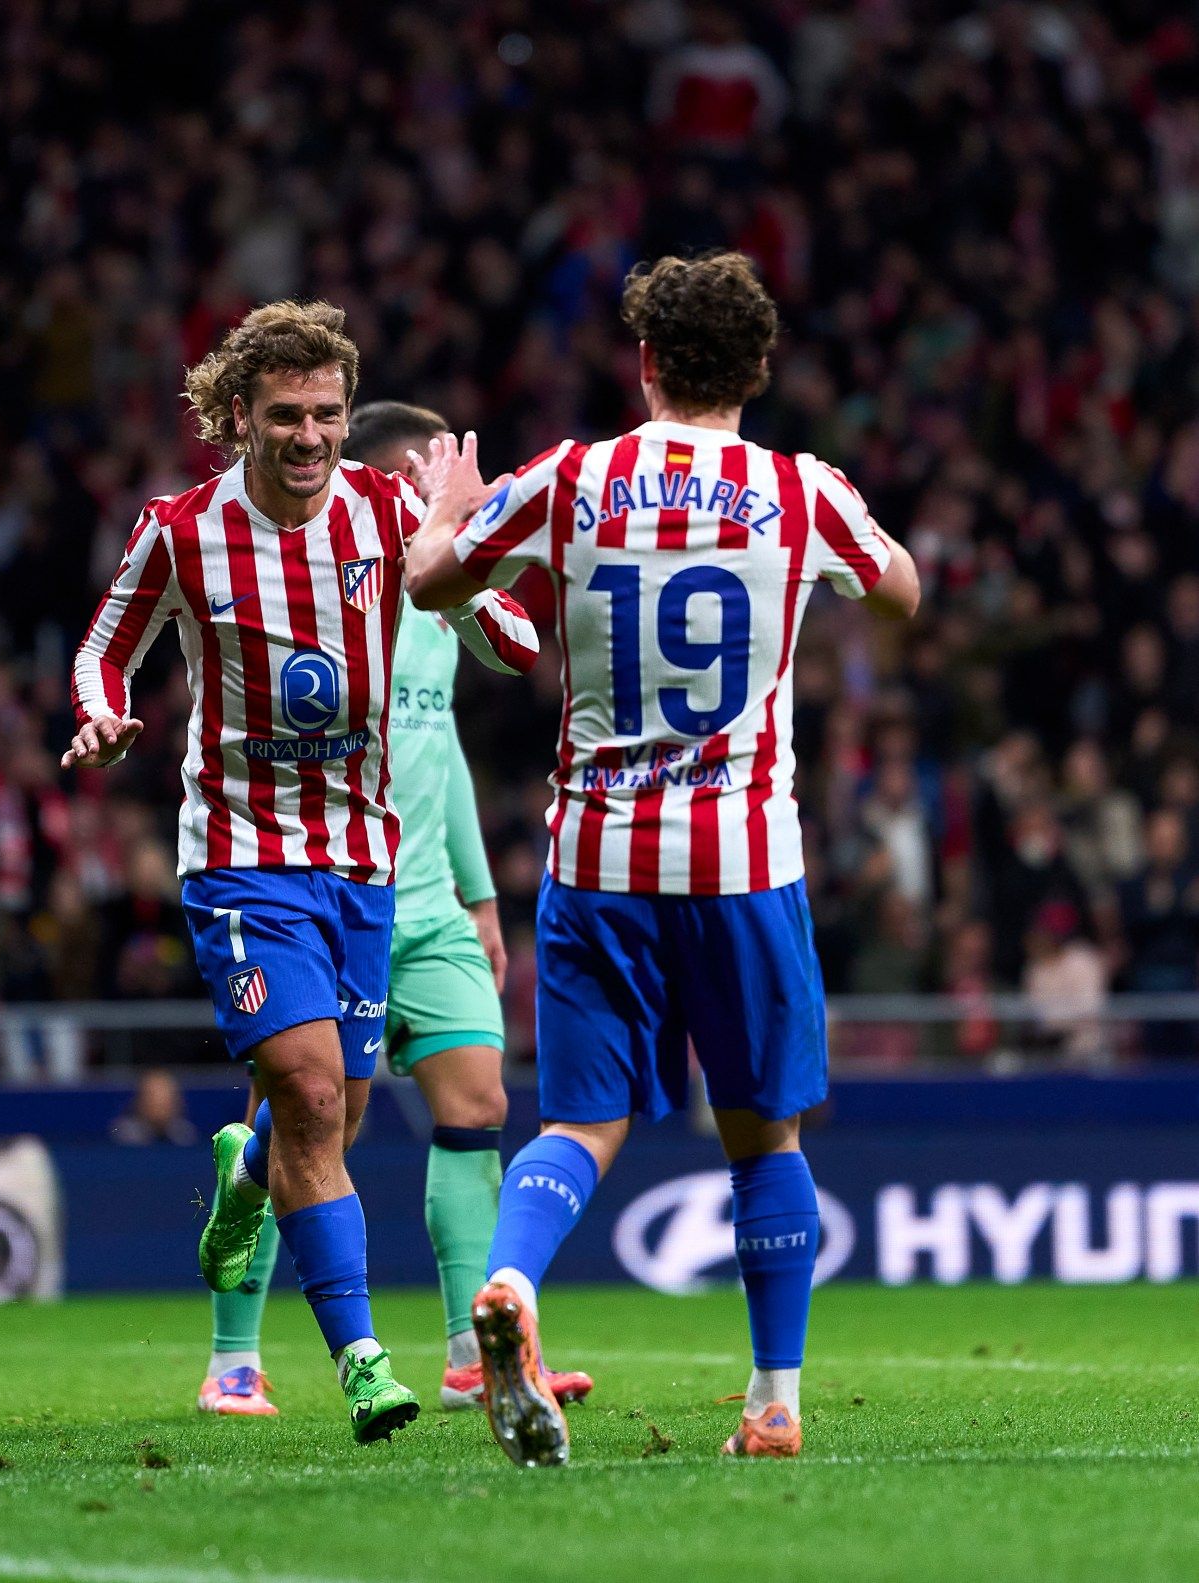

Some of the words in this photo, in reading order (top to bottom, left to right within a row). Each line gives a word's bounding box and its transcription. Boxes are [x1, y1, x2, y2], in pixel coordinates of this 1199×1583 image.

[573, 472, 783, 536] J.ALVAREZ
[587, 564, 751, 737] 19
[250, 740, 330, 758] RIYADH
[337, 732, 365, 756] AIR
[213, 908, 247, 963] 7
[518, 1175, 580, 1216] ATLETI
[738, 1231, 807, 1251] ATLETI
